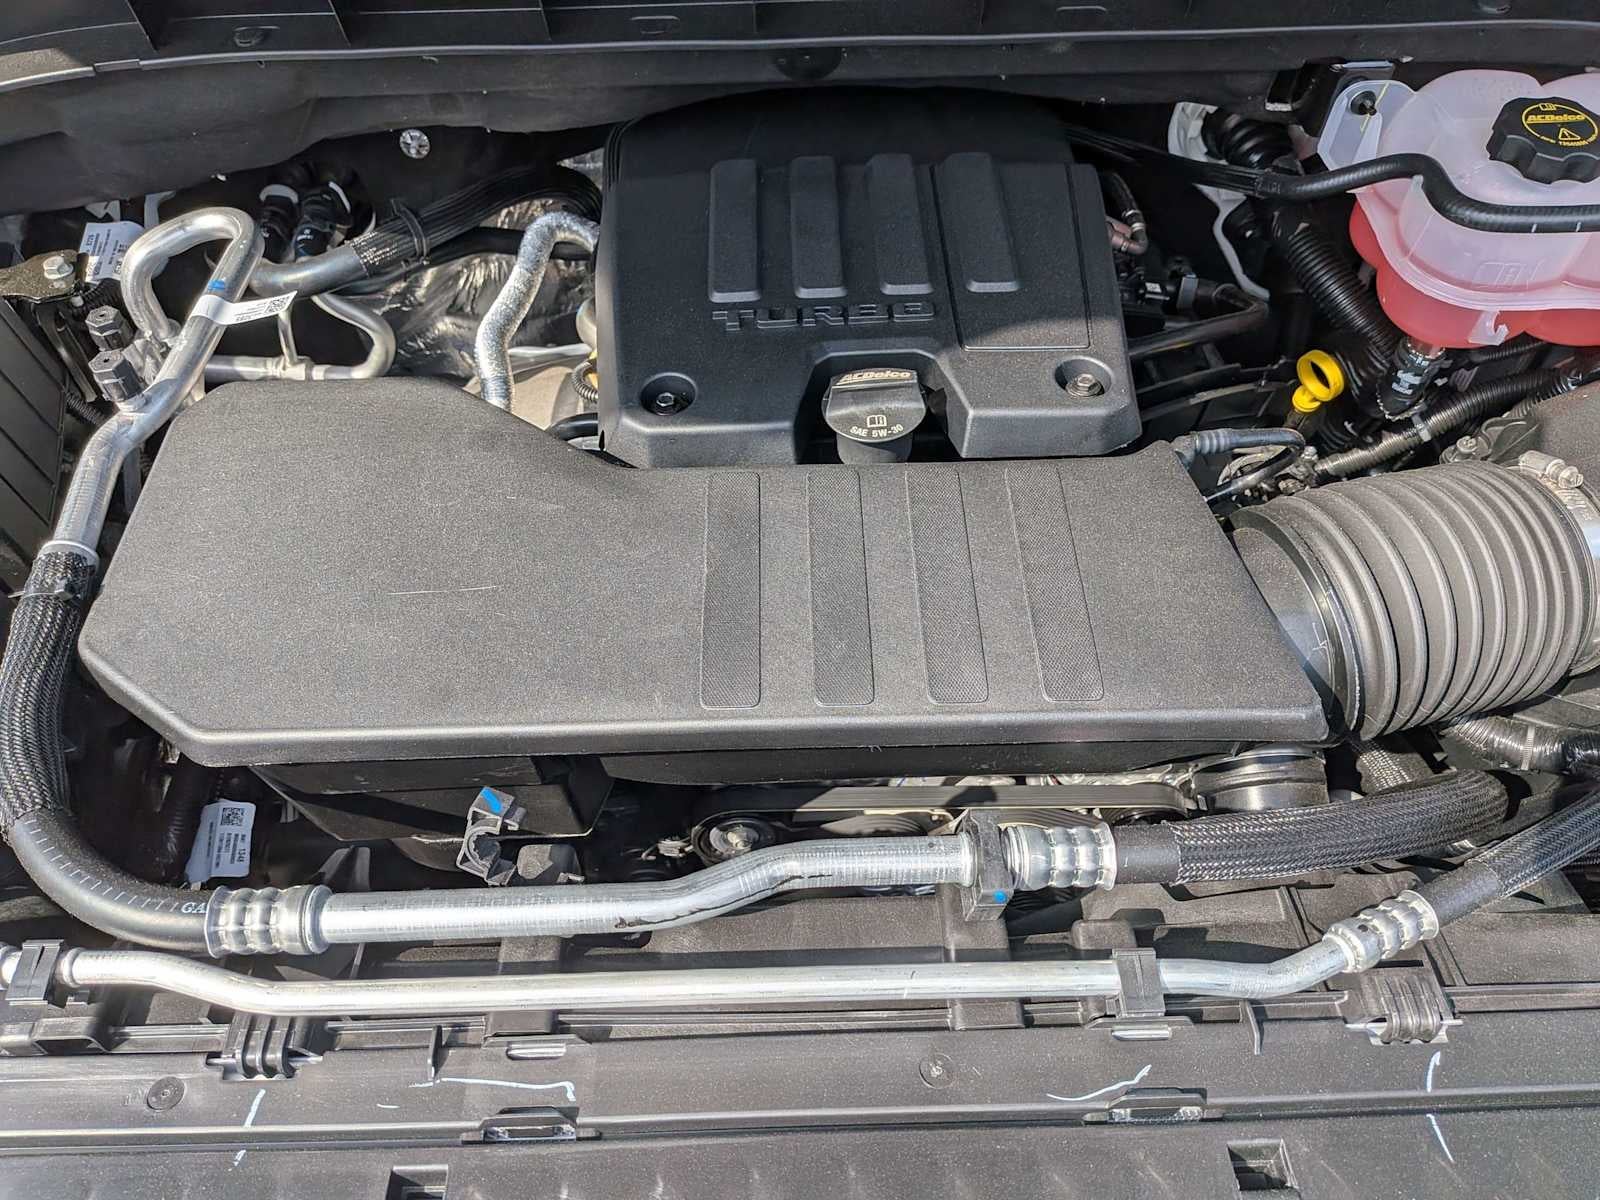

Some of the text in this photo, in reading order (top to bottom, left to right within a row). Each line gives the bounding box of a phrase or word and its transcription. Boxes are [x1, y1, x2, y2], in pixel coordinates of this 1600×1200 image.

[1526, 113, 1586, 124] ACDelco
[711, 302, 935, 331] TURBO
[836, 370, 911, 385] ACDelco
[850, 423, 904, 438] SAE 5W-30
